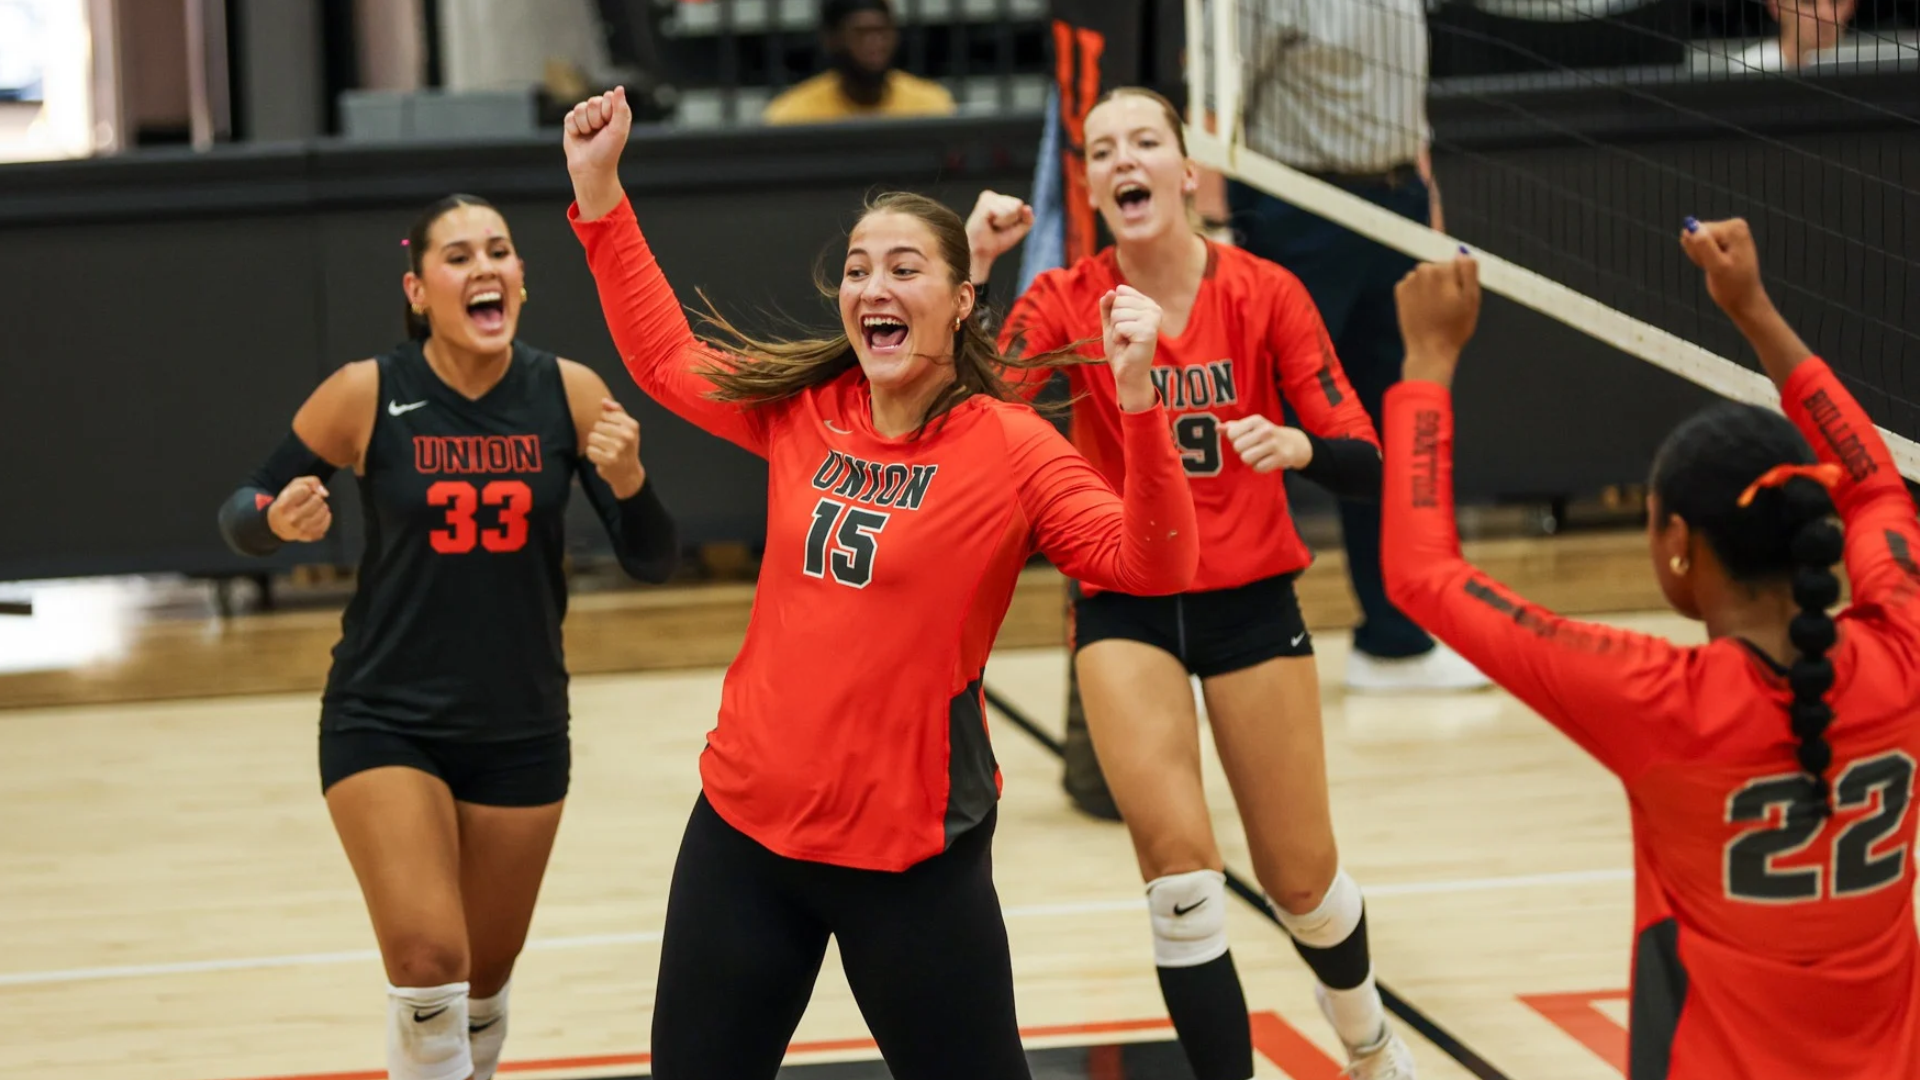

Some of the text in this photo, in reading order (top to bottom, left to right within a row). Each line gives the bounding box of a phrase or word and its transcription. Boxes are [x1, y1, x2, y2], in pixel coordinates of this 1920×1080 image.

[1150, 359, 1238, 411] NION
[412, 434, 542, 474] UNION
[1172, 411, 1223, 477] 9
[1803, 388, 1878, 483] BULLDOGS
[811, 449, 939, 511] UNION
[426, 480, 533, 555] 33
[803, 497, 891, 589] 15
[1723, 748, 1916, 905] 22
